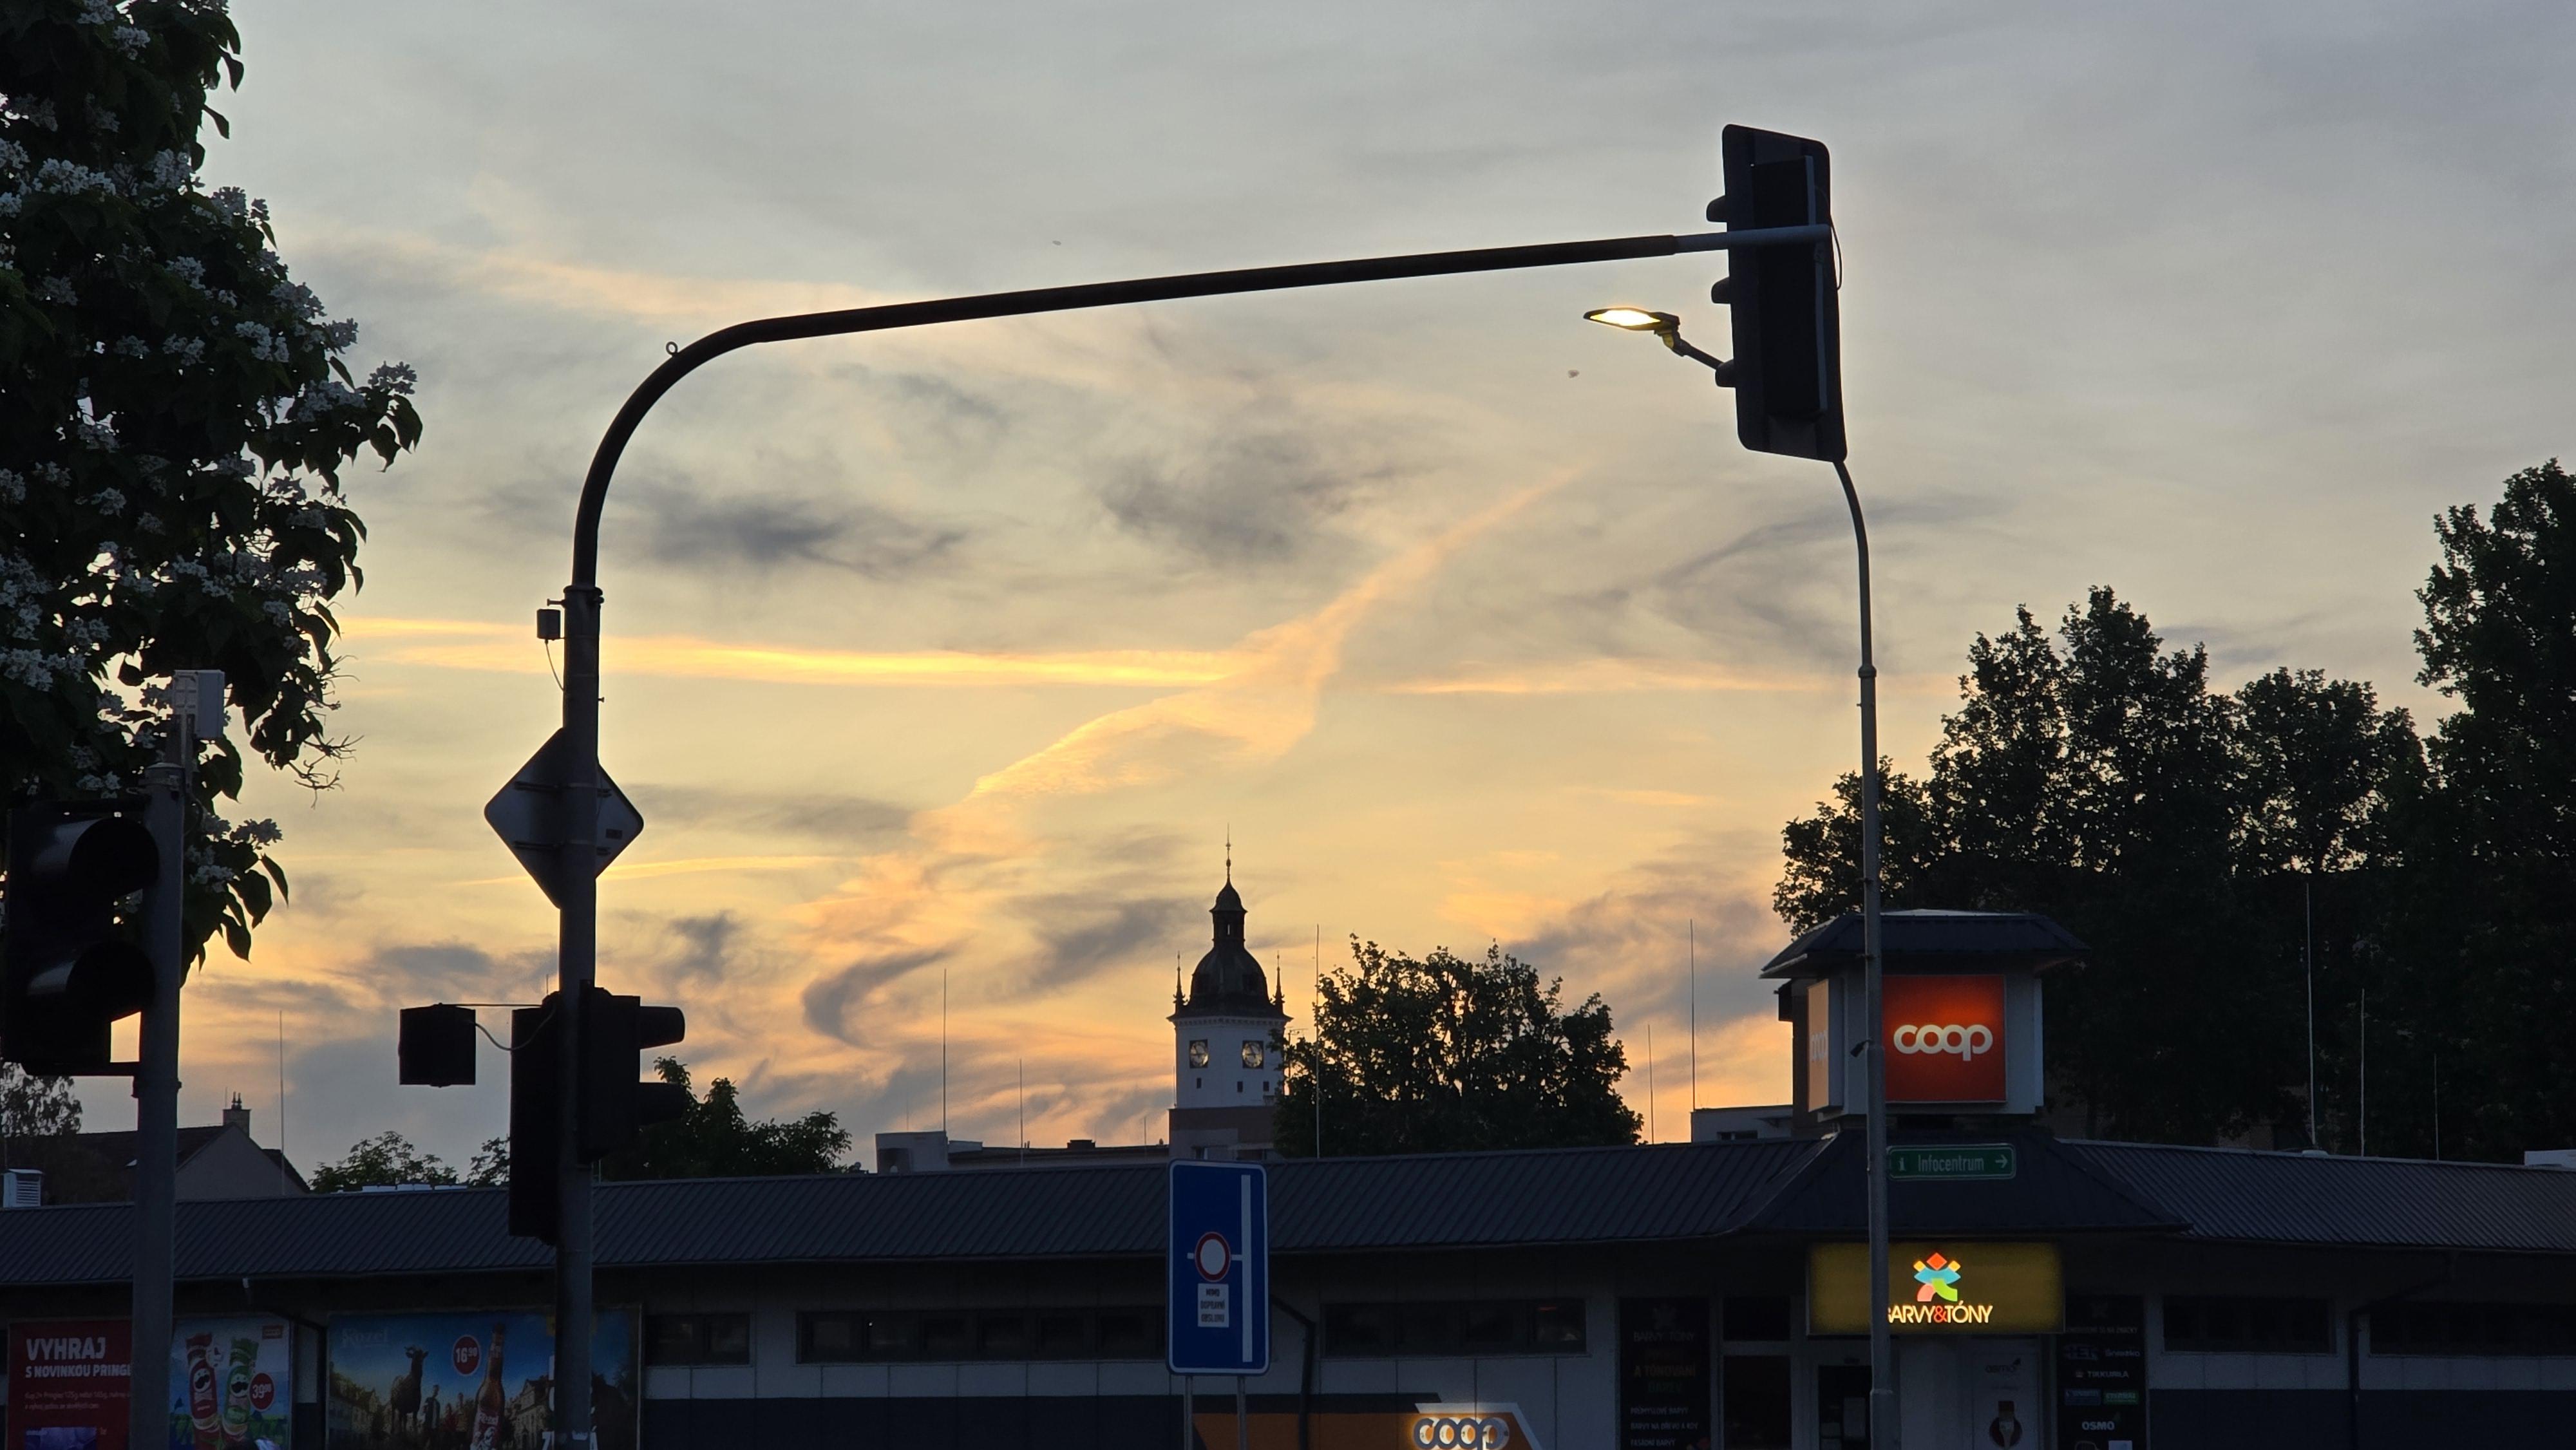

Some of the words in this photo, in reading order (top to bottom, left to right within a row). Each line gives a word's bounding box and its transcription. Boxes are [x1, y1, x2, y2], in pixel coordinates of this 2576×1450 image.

[1893, 1024, 1993, 1061] coop
[1918, 1154, 1984, 1172] Infocentrum
[26, 1337, 106, 1361] VYHRAJ
[26, 1366, 32, 1378] S
[34, 1364, 91, 1378] NOVINKOU
[1414, 1417, 1510, 1450] coop
[2081, 1421, 2116, 1431] OSMO
